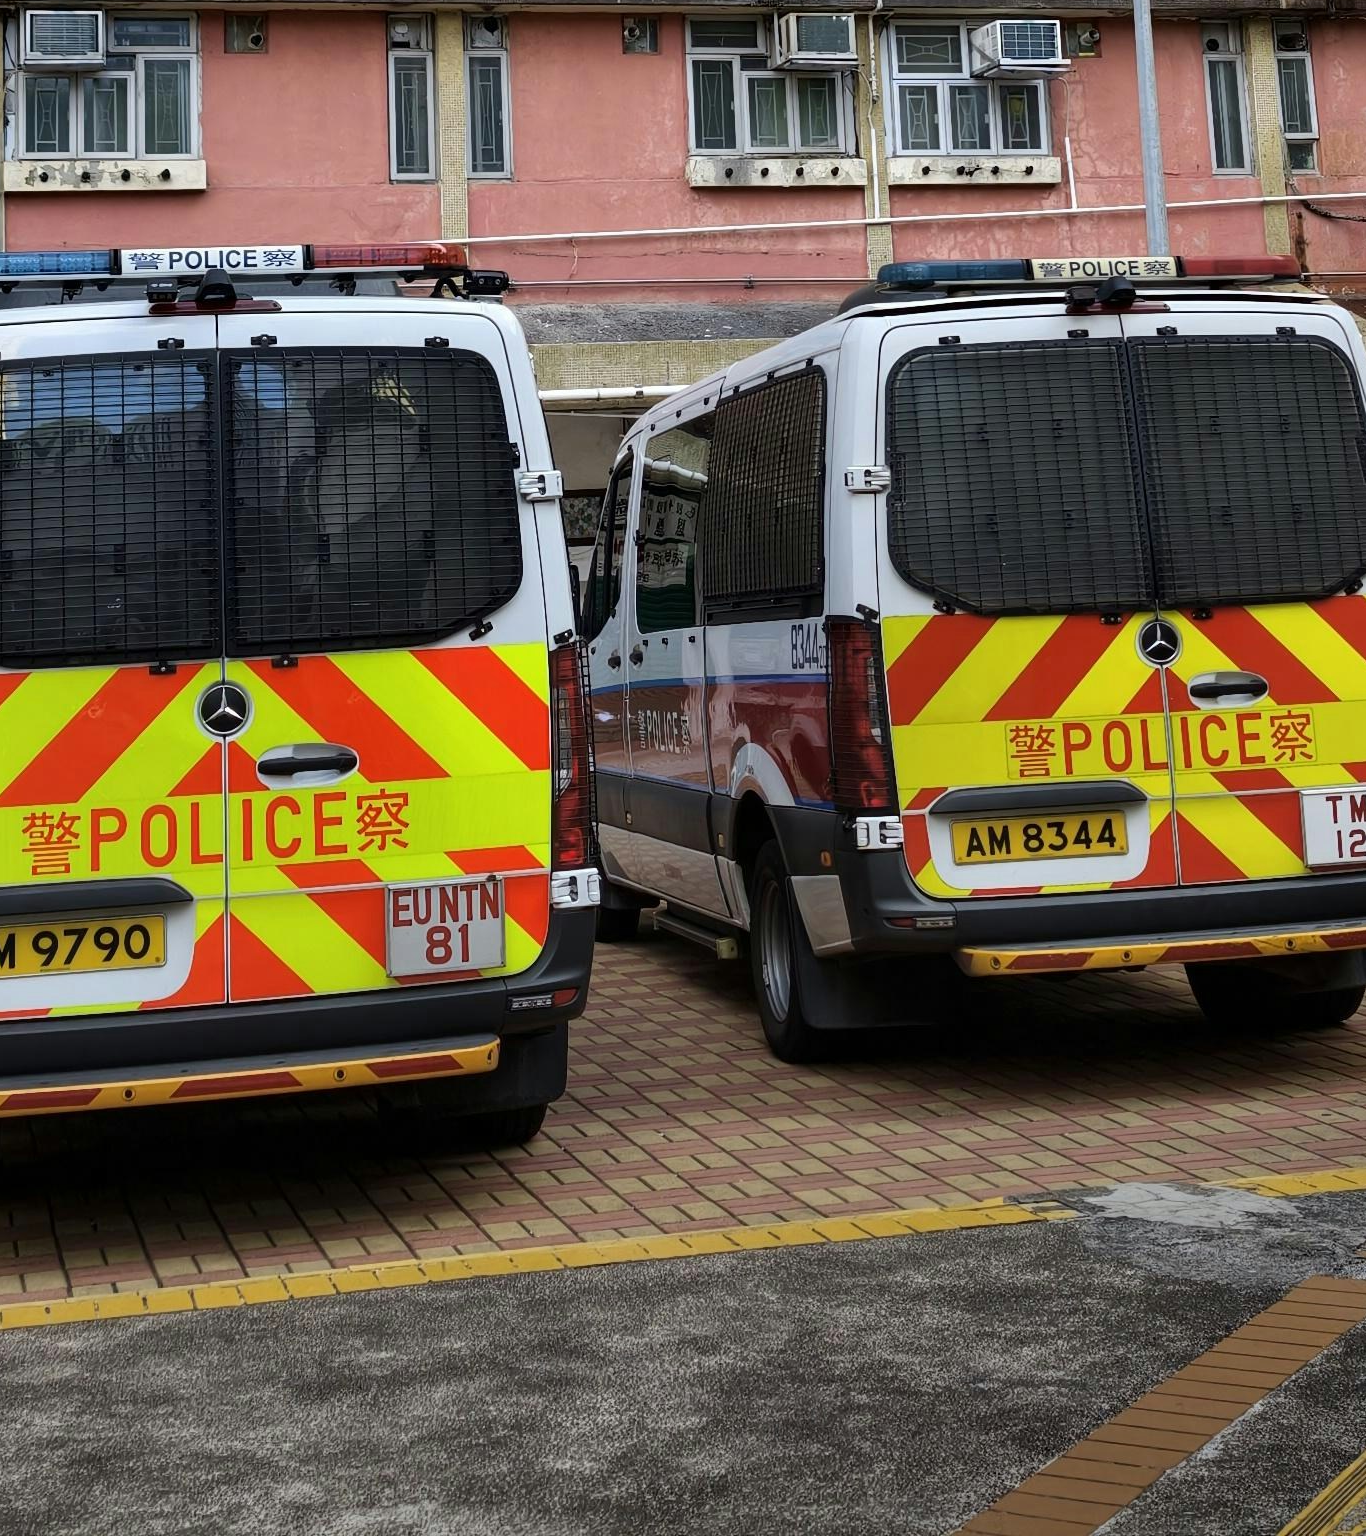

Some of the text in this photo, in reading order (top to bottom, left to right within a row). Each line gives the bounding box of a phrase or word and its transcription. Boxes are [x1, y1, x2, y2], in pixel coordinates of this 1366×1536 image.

[965, 818, 1117, 857] AM 8344
[31, 923, 151, 968] 9790
[425, 923, 470, 965] 81
